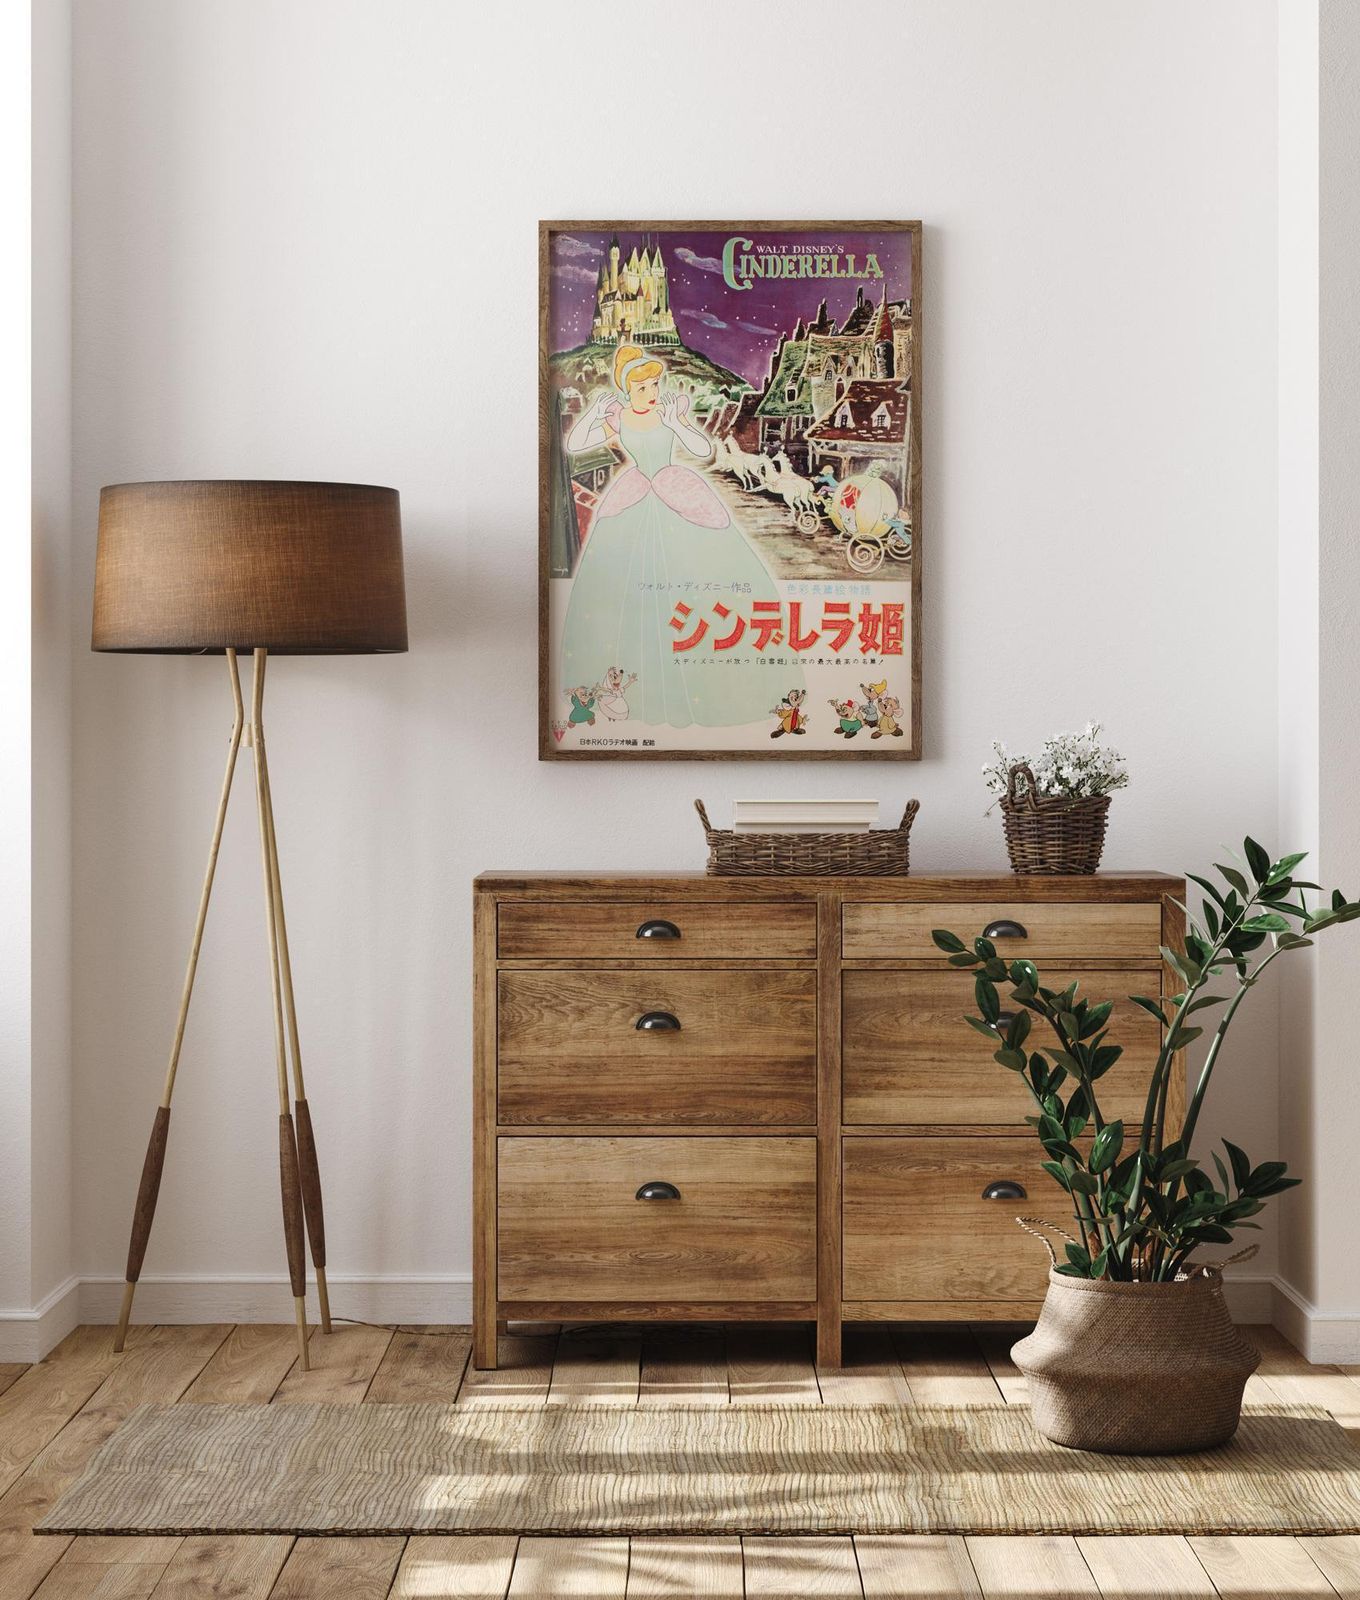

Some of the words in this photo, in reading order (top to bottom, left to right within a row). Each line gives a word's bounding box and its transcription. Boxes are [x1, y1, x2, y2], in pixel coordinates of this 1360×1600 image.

[722, 237, 883, 290] CINDERELLA
[756, 245, 788, 254] WALT
[793, 244, 844, 254] DISNEY'S
[669, 601, 904, 655] シンデレラ姫
